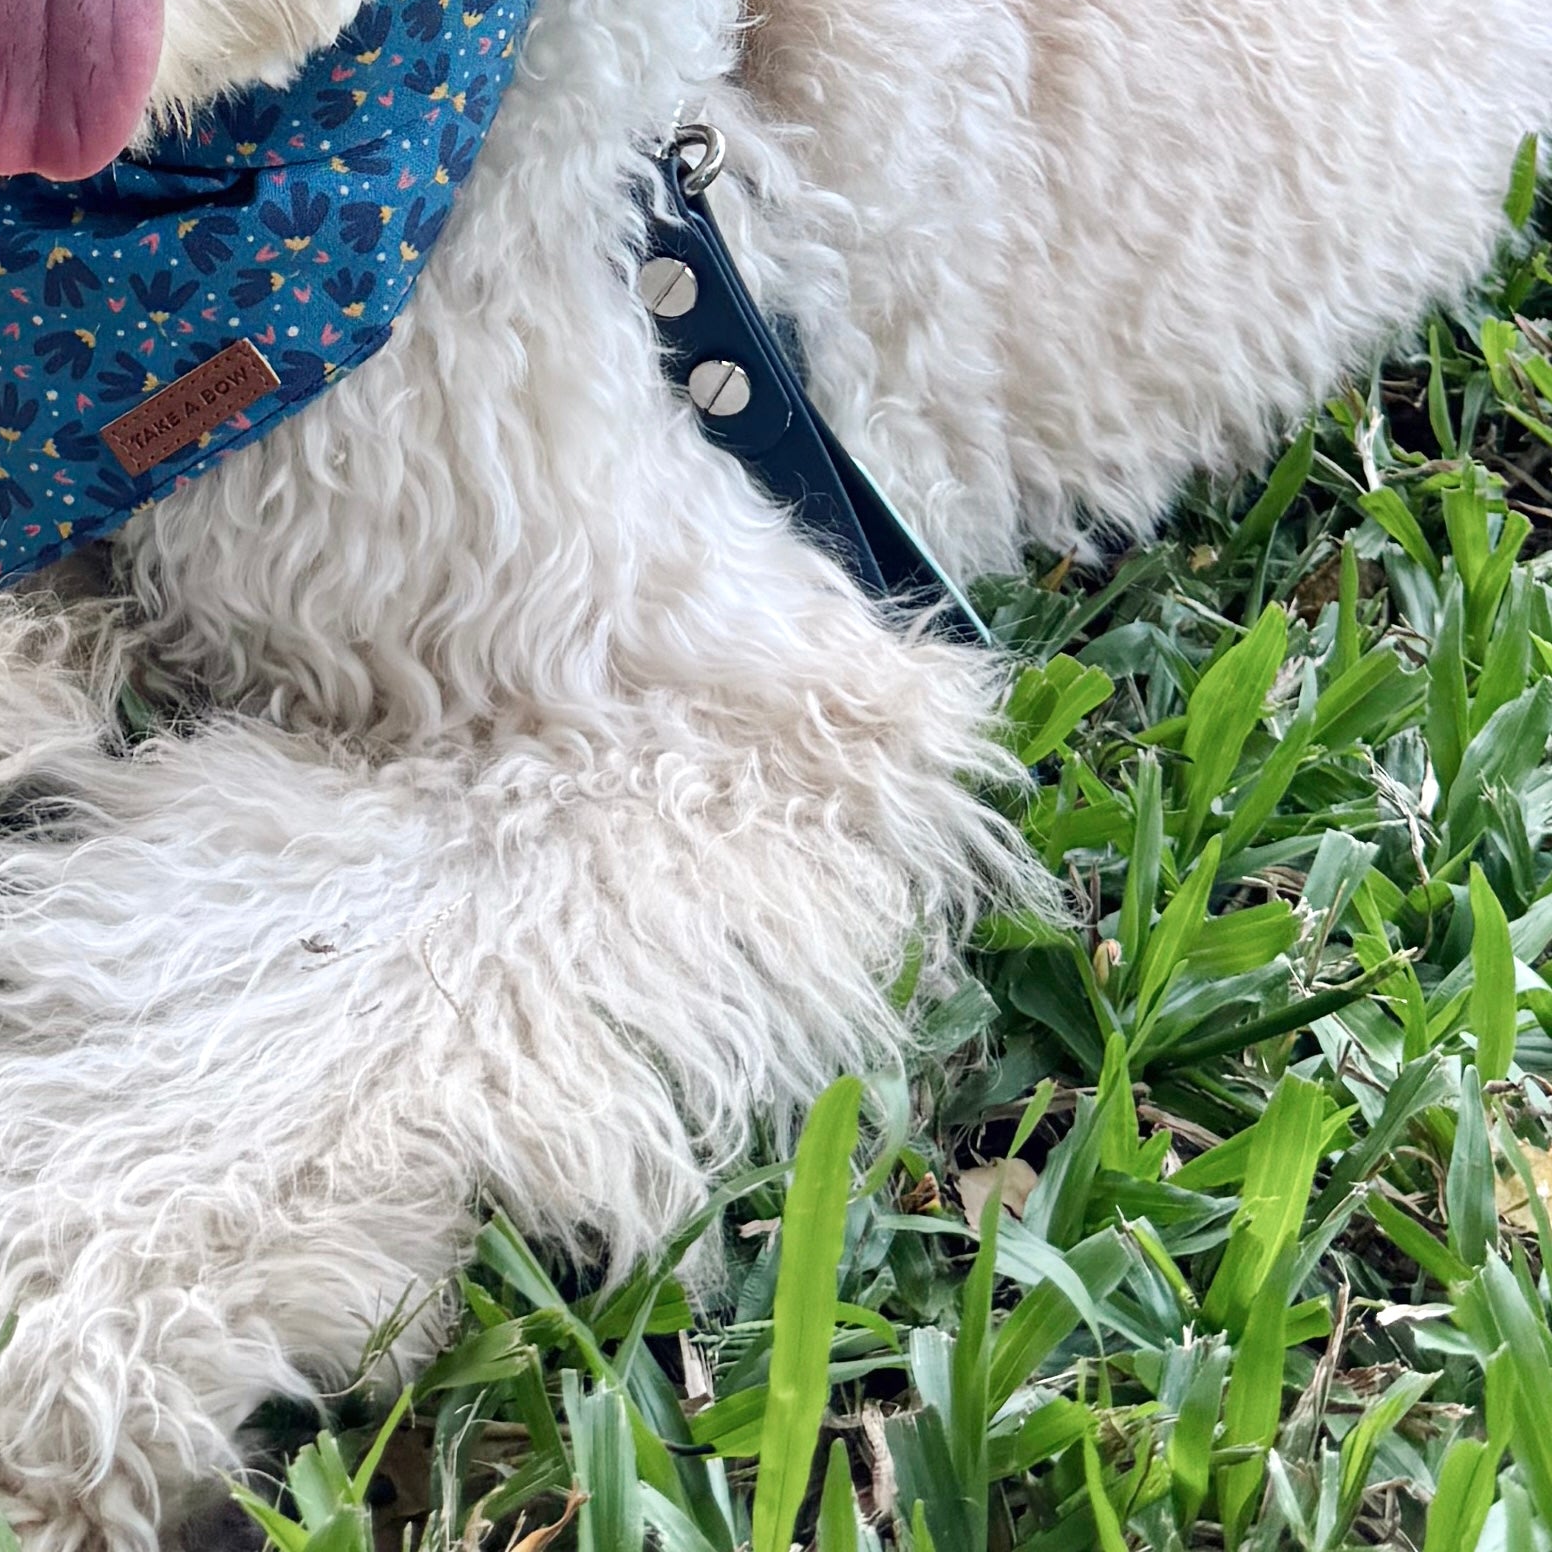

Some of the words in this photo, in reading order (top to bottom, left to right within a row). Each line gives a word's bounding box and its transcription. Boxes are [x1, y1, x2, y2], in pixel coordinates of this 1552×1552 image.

[131, 412, 181, 449] TAKE
[184, 401, 200, 418] A
[199, 367, 249, 405] BOW
